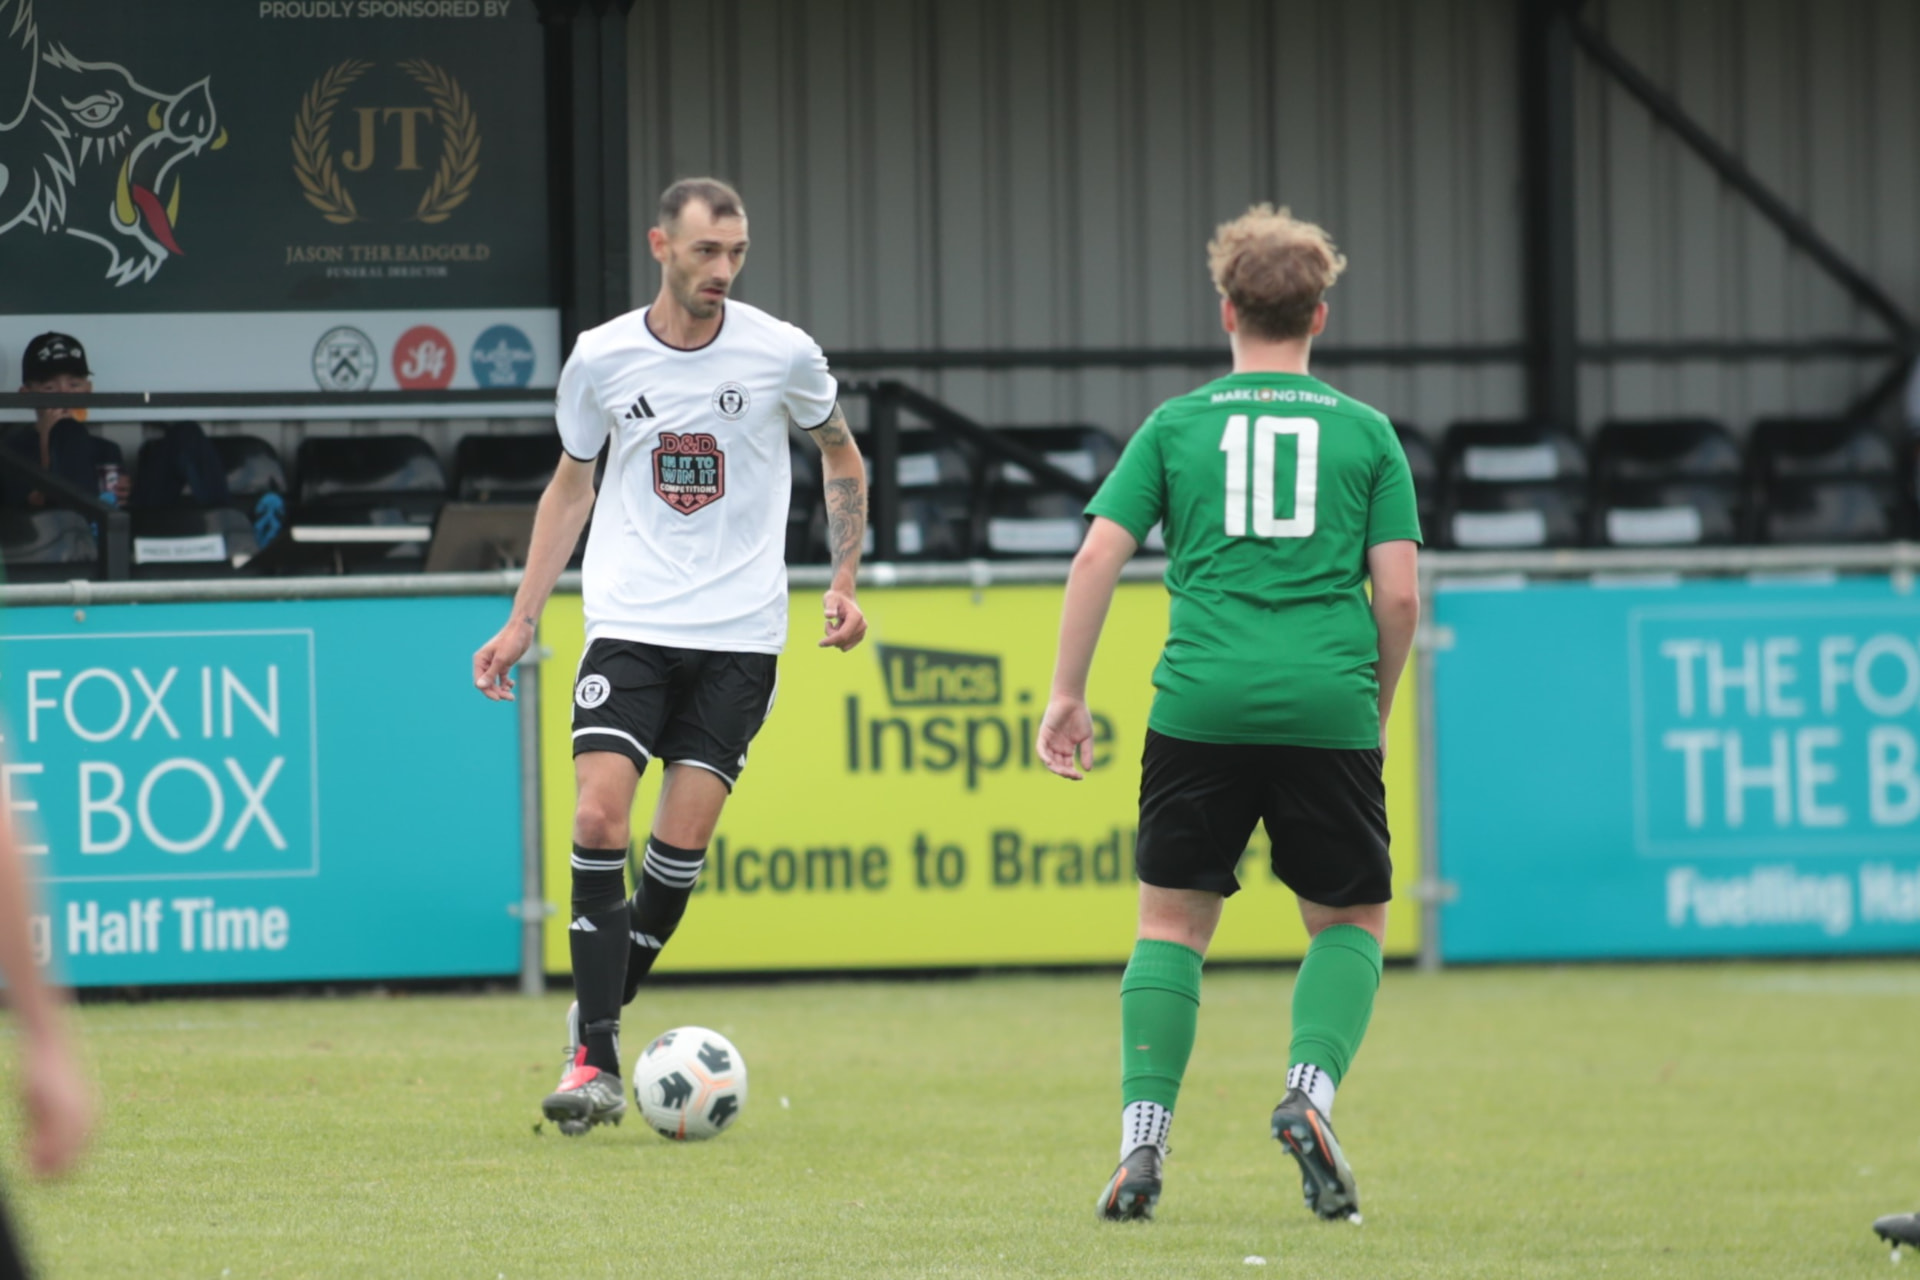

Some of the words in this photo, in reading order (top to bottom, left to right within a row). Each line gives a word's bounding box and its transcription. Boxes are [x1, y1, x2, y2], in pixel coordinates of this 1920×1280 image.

[259, 1, 353, 19] PROUDLY
[357, 1, 480, 18] SPONSORED
[484, 0, 511, 17] BY
[342, 107, 434, 173] JT
[286, 245, 344, 264] JASON
[349, 243, 490, 262] THREADGOLD
[1211, 389, 1252, 404] MARK
[1298, 390, 1339, 407] TRUST
[660, 433, 716, 455] D&D
[662, 455, 677, 469] IN
[679, 456, 693, 469] IT
[695, 456, 715, 469] TO
[660, 483, 717, 494] COMPETITIONS
[661, 467, 695, 484] WIN
[699, 469, 716, 485] IT
[1219, 414, 1319, 538] 10
[27, 667, 181, 742] FOX
[201, 665, 281, 739] IN
[891, 655, 998, 702] Lincs
[1660, 636, 1805, 719] THE
[1818, 632, 1920, 718] FO
[846, 691, 1116, 791] Inspie
[79, 756, 288, 856] BOX
[1662, 727, 1848, 828] THE
[912, 832, 966, 889] to
[991, 826, 1138, 887] Bradl
[67, 898, 163, 956] Half
[171, 896, 290, 952] Time
[1666, 864, 1853, 935] Fuelling
[1859, 862, 1920, 924] Ha
